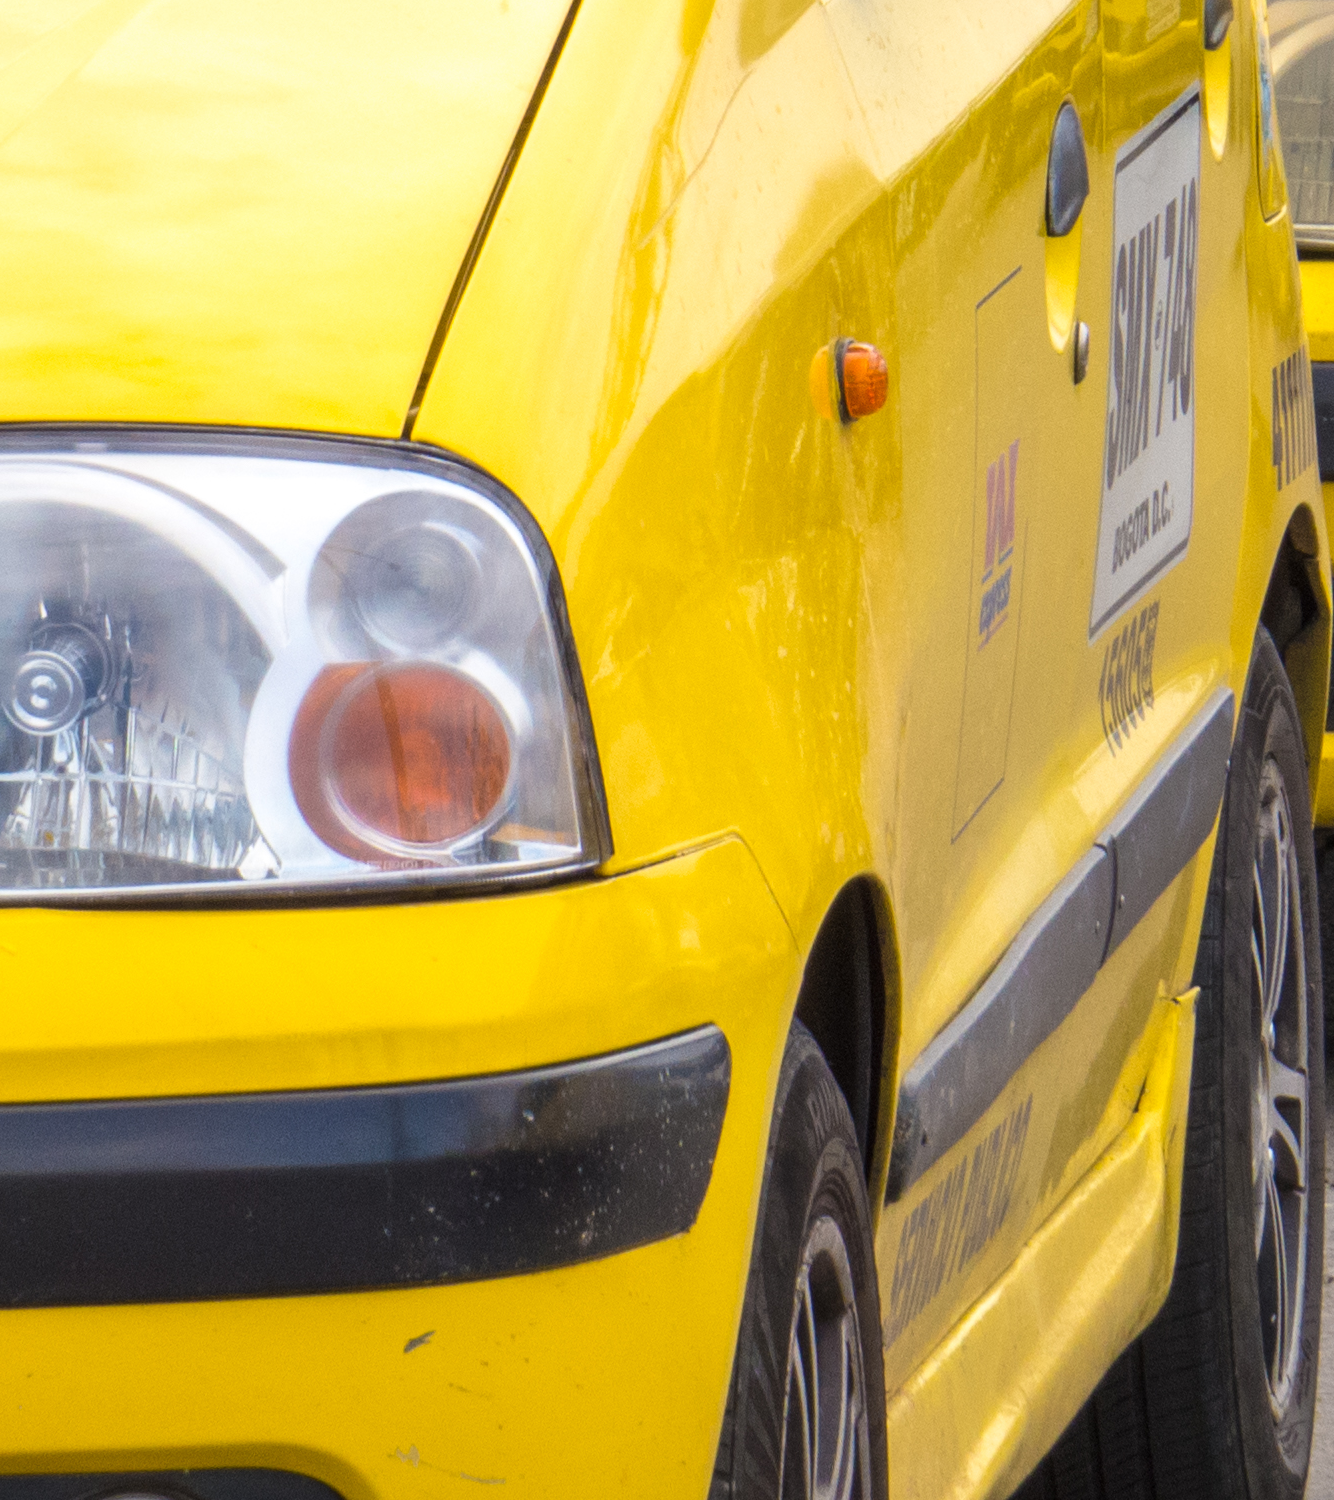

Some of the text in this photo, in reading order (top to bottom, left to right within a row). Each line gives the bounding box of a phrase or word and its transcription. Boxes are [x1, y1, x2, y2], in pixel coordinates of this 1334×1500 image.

[1107, 176, 1196, 491] SMX 748
[1112, 498, 1149, 575] BOGOTA
